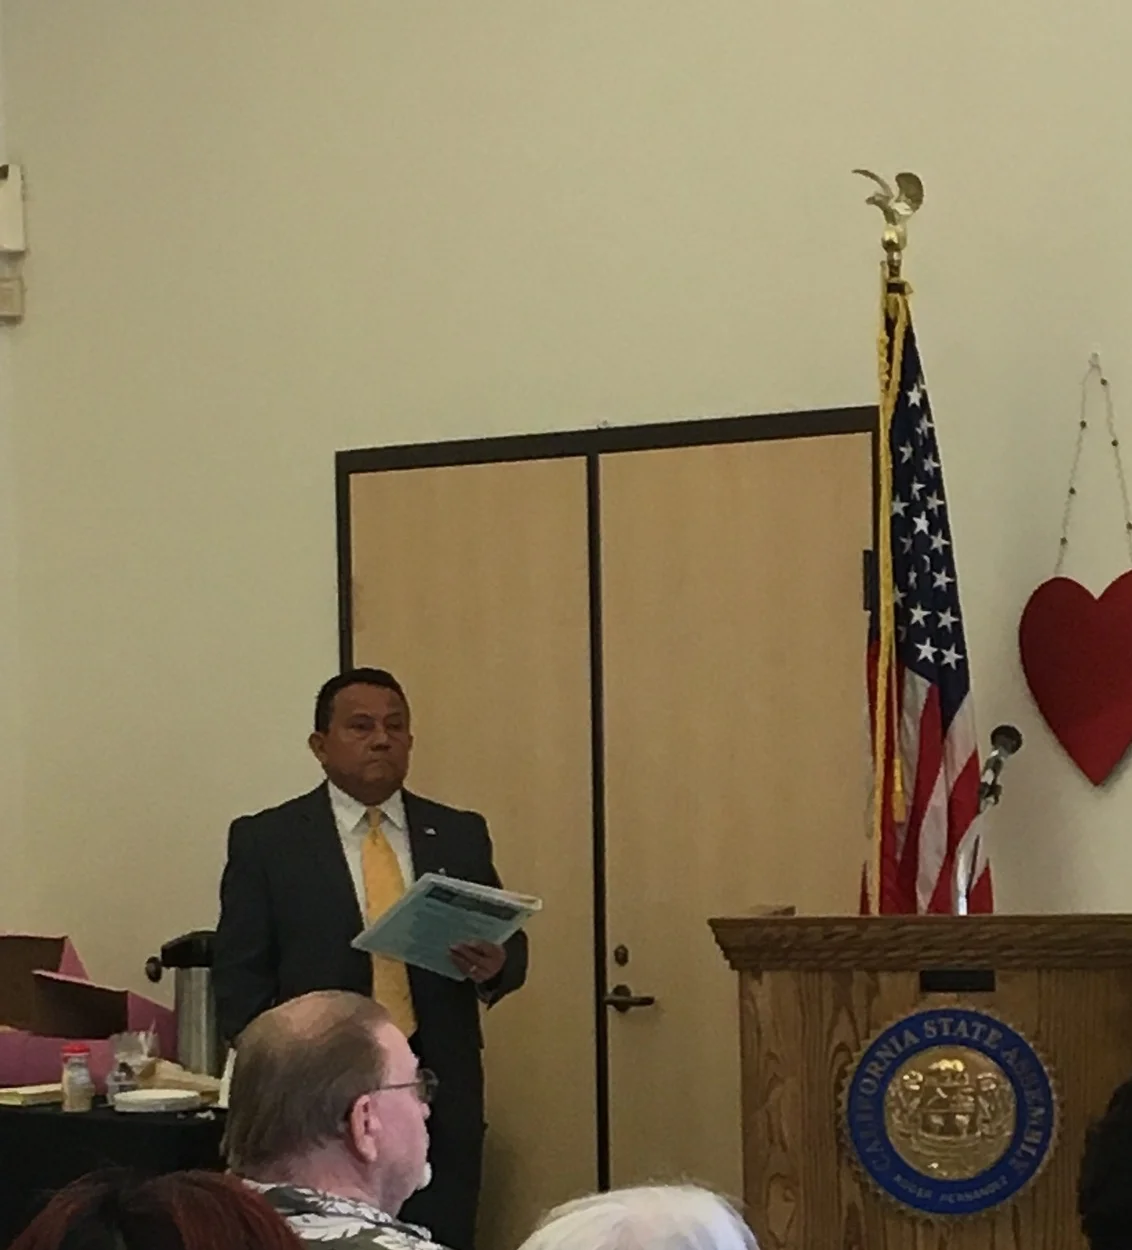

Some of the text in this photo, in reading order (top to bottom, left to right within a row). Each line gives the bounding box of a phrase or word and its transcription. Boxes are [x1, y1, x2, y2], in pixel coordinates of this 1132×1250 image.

[856, 1017, 1046, 1175] CALIFORNIA STATE ASSEMBLY
